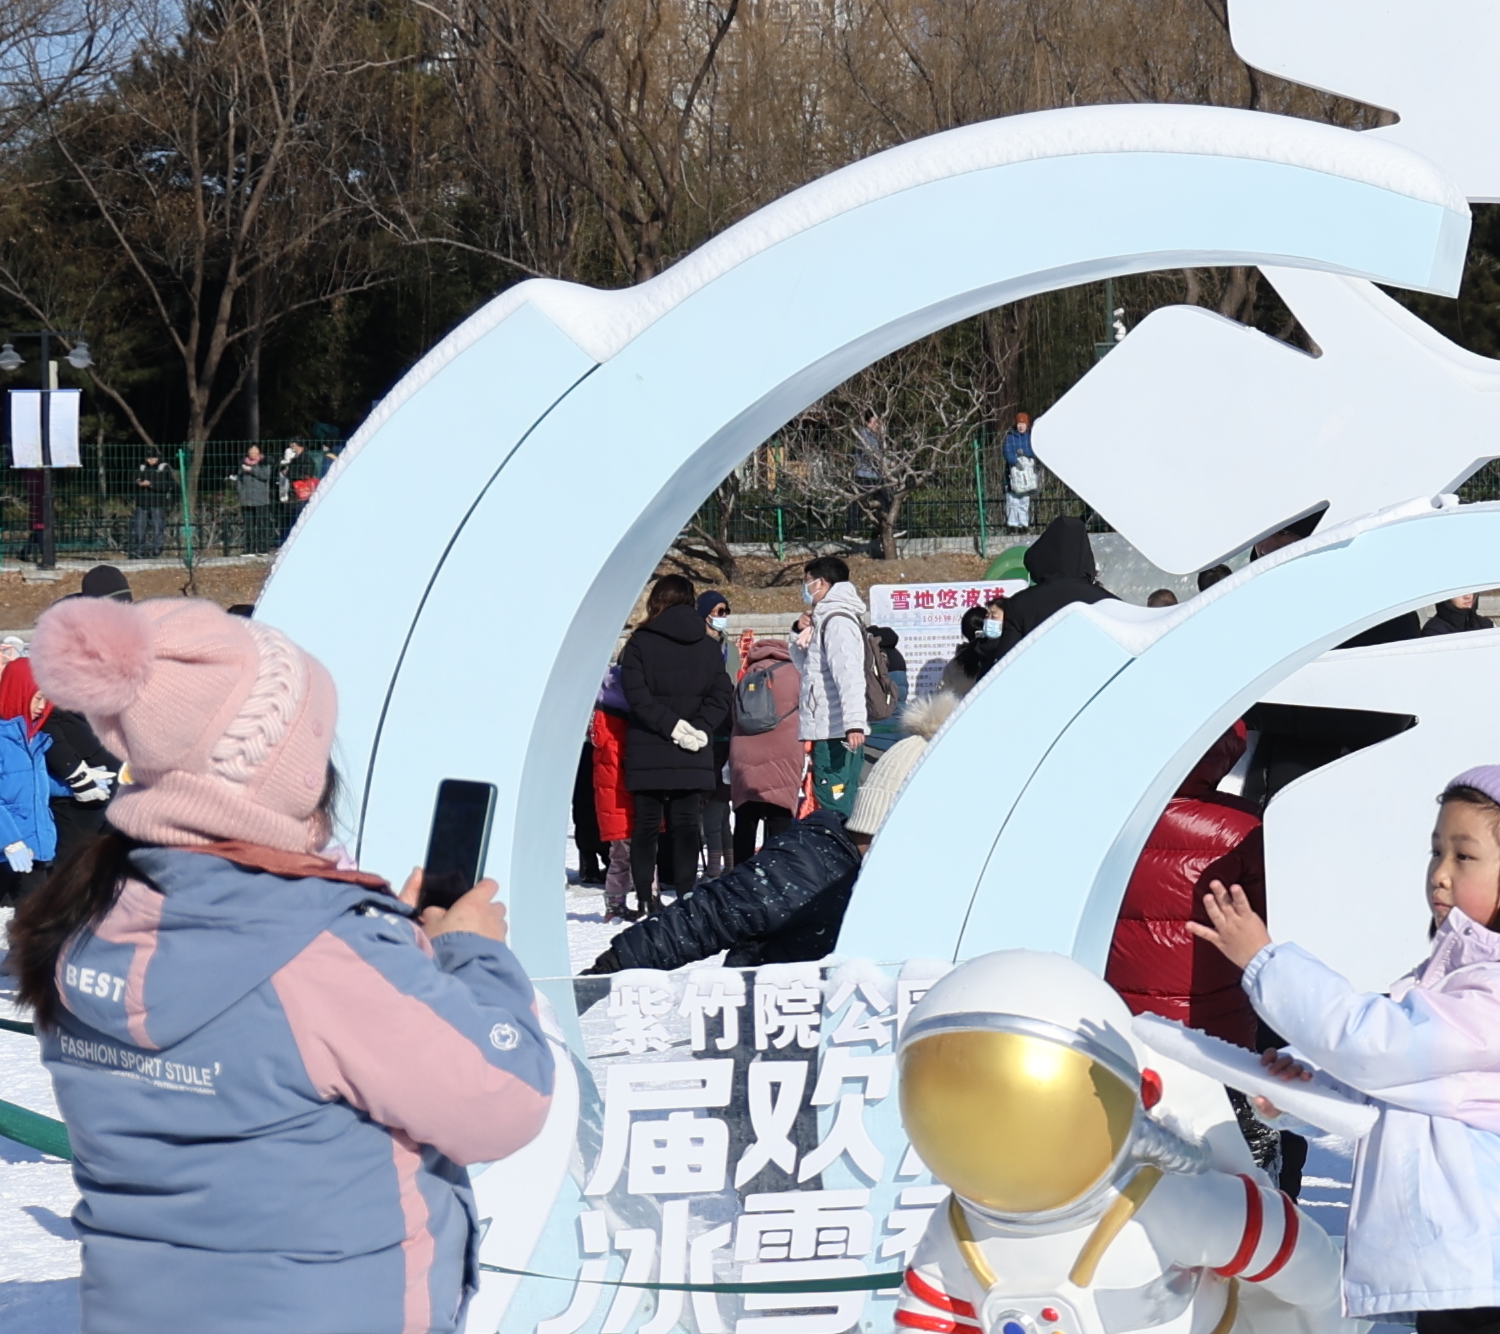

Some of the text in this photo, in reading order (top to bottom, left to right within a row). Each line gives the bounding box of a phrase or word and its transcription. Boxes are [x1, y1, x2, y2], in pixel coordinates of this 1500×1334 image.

[890, 587, 1006, 610] 雪地悠波球
[65, 963, 125, 1003] BEST
[119, 1050, 163, 1079] SPORT
[584, 1045, 924, 1196] 届欢
